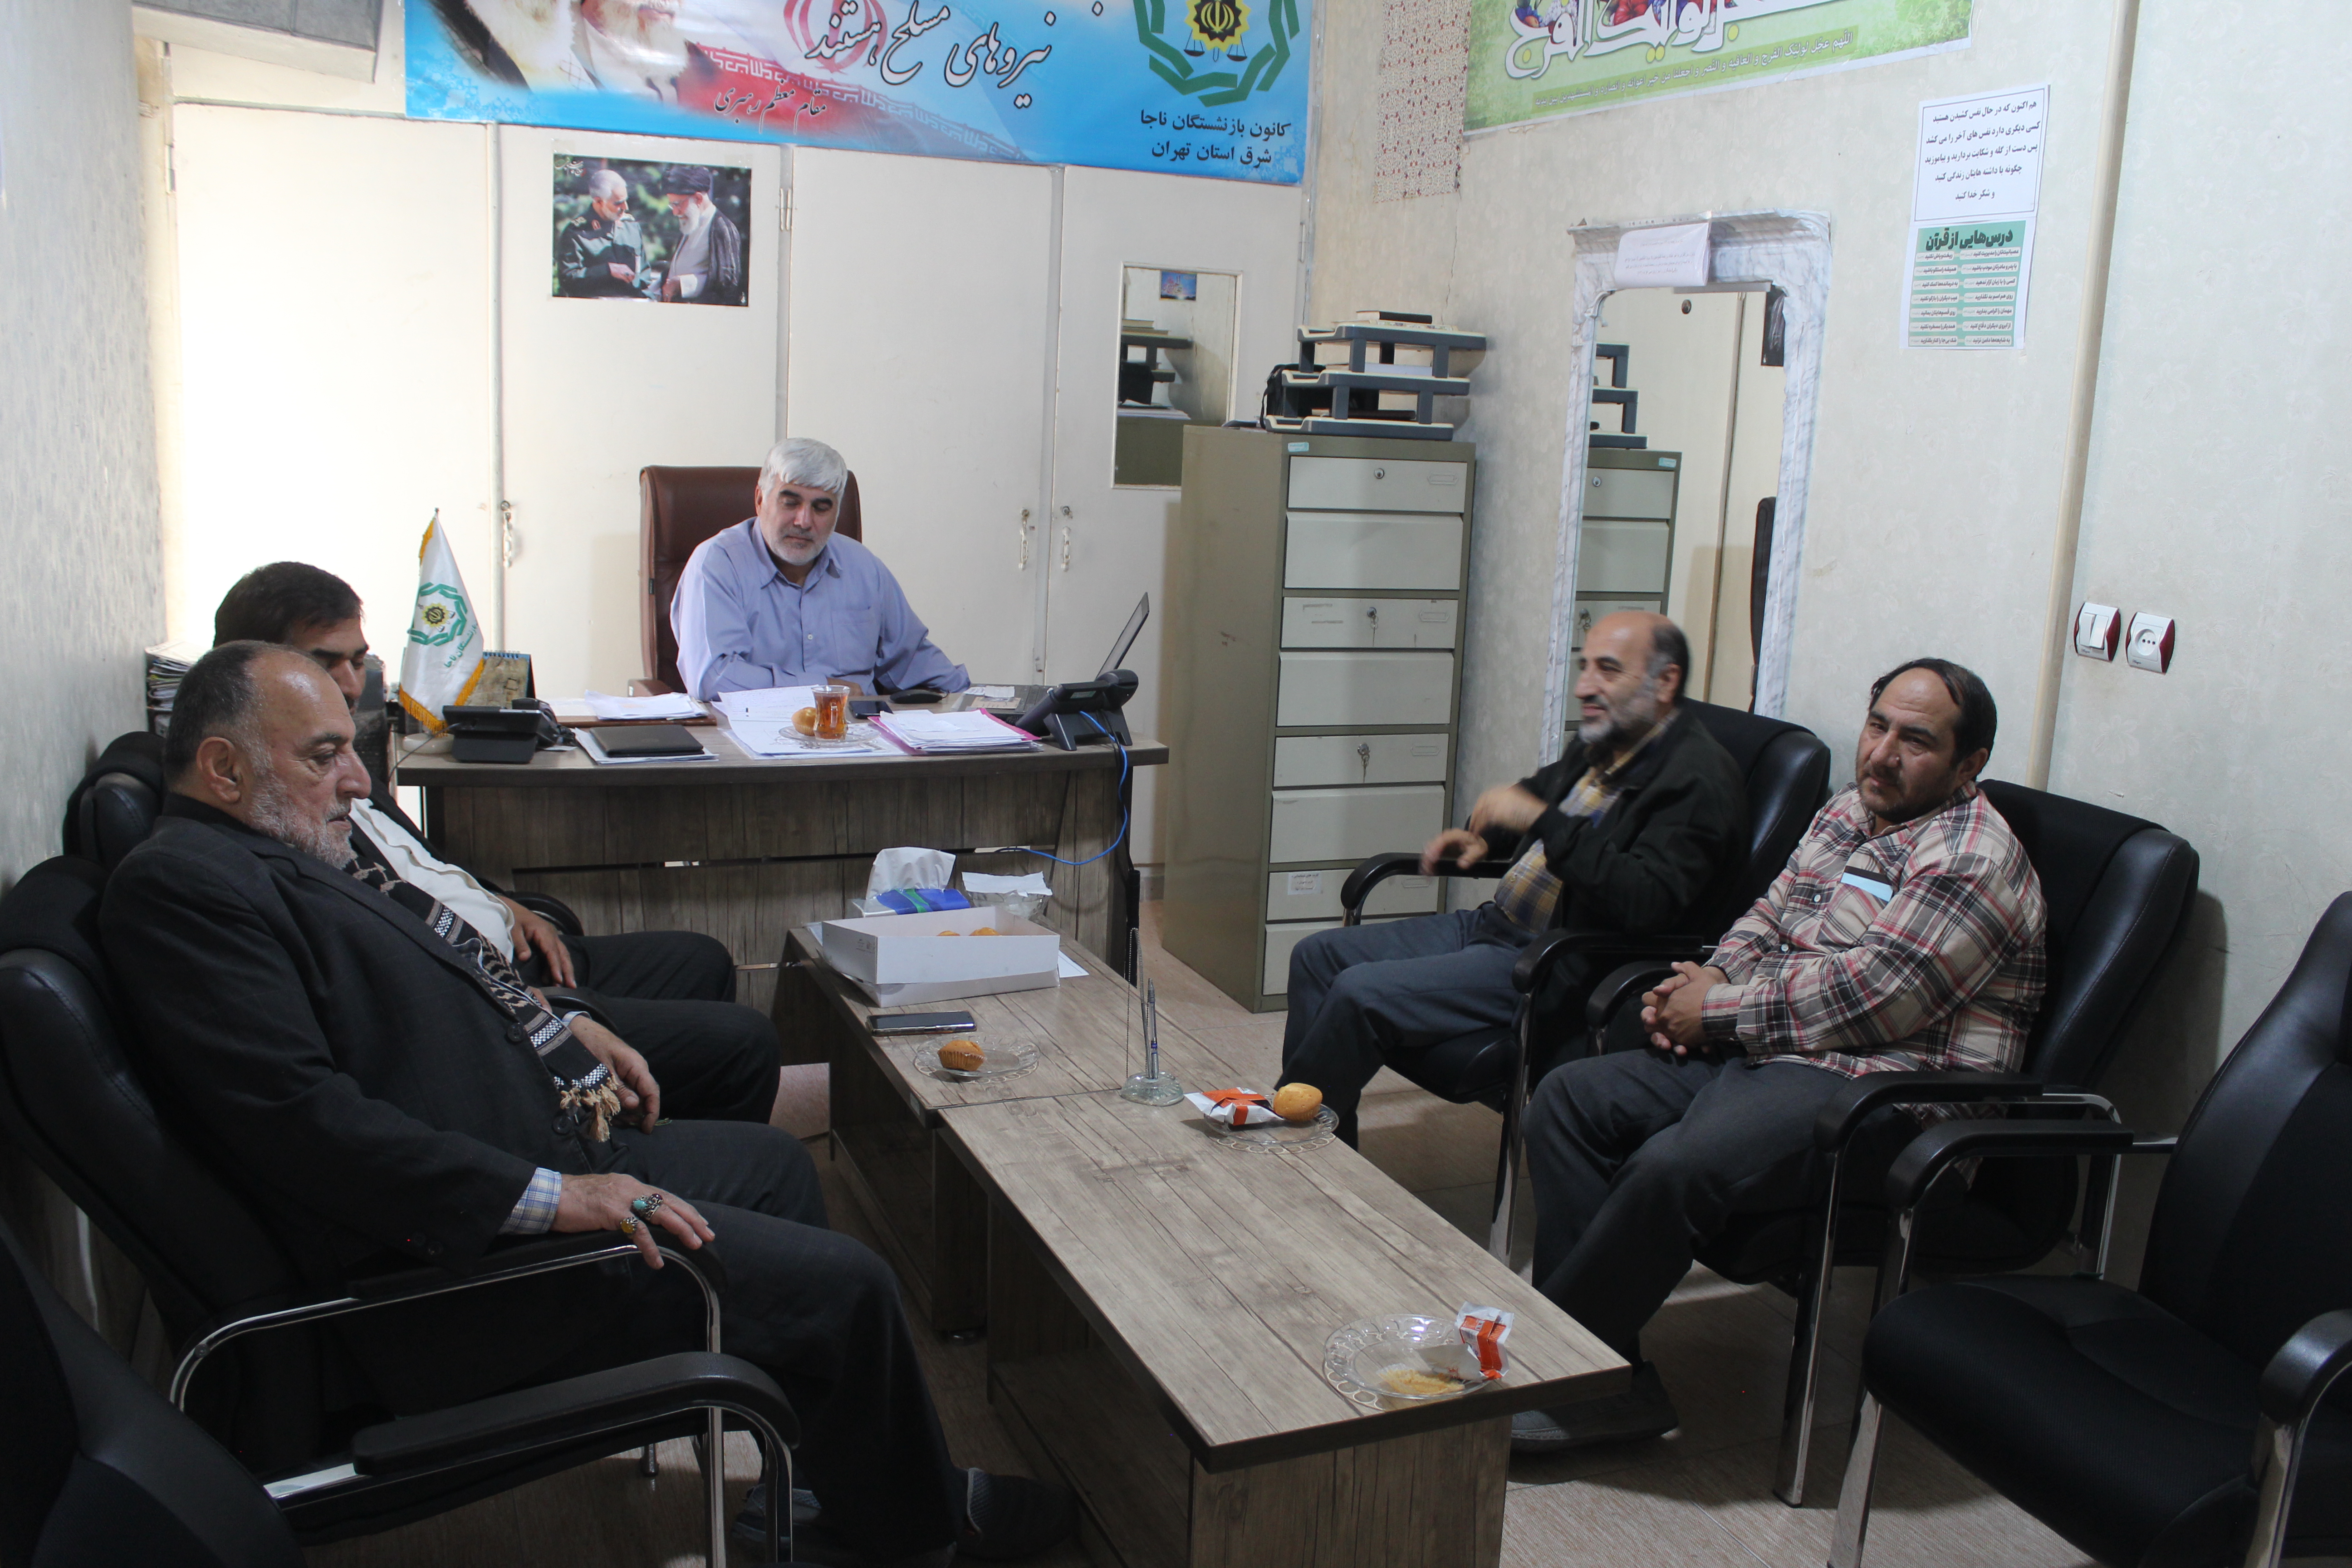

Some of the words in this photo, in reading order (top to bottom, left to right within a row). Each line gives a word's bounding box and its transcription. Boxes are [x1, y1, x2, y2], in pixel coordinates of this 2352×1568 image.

[805, 1, 882, 66] هستند
[881, 0, 951, 85] مسلح
[944, 10, 1052, 109] نیروهای
[1754, 56, 1759, 65] و
[1761, 47, 1782, 65] الفرج
[1673, 65, 1693, 78] اجعلنا
[1695, 68, 1700, 77] و
[1722, 63, 1726, 72] و
[1647, 73, 1659, 87] خیر
[1661, 72, 1671, 83] من
[1595, 88, 1599, 97] و
[1621, 83, 1625, 91] و
[714, 88, 761, 124] رهبری
[759, 78, 795, 133] معظم
[1996, 106, 2002, 116] در
[2003, 103, 2010, 112] که
[2011, 100, 2028, 113] اکنون
[2029, 101, 2037, 111] هم
[1950, 110, 1969, 122] کشیدن
[1969, 107, 1981, 119] نفس
[1982, 106, 1993, 118] حال
[1140, 108, 1167, 128] ناجا
[1172, 113, 1245, 137] بازنشستگان
[2005, 124, 2024, 136] دیگری
[2026, 121, 2041, 133] کسی
[1250, 122, 1291, 142] کانون
[1954, 130, 1966, 143] آخر
[1967, 130, 1978, 141] های
[1979, 130, 1991, 139] نفس
[1992, 126, 2004, 137] دارد
[1926, 136, 1938, 144] کشد
[1948, 134, 1954, 143] را
[1152, 140, 1191, 162] تهران
[1197, 143, 1235, 161] استان
[1971, 147, 1989, 158] شکایت
[2004, 145, 2010, 156] از
[2027, 144, 2038, 153] پس
[1240, 147, 1271, 169] شرق
[1951, 151, 1971, 162] بردارید
[1965, 170, 1981, 180] هایتان
[1983, 167, 1998, 175] داشته
[1999, 167, 2004, 175] با
[2004, 164, 2022, 176] چگونه
[1935, 172, 1946, 182] کنید
[1947, 171, 1965, 182] زندگی
[1955, 191, 1967, 200] کنید
[1967, 189, 1977, 199] خدا
[1979, 189, 1990, 200] شکر
[1926, 228, 1950, 250] قرآن
[1947, 231, 1959, 250] از
